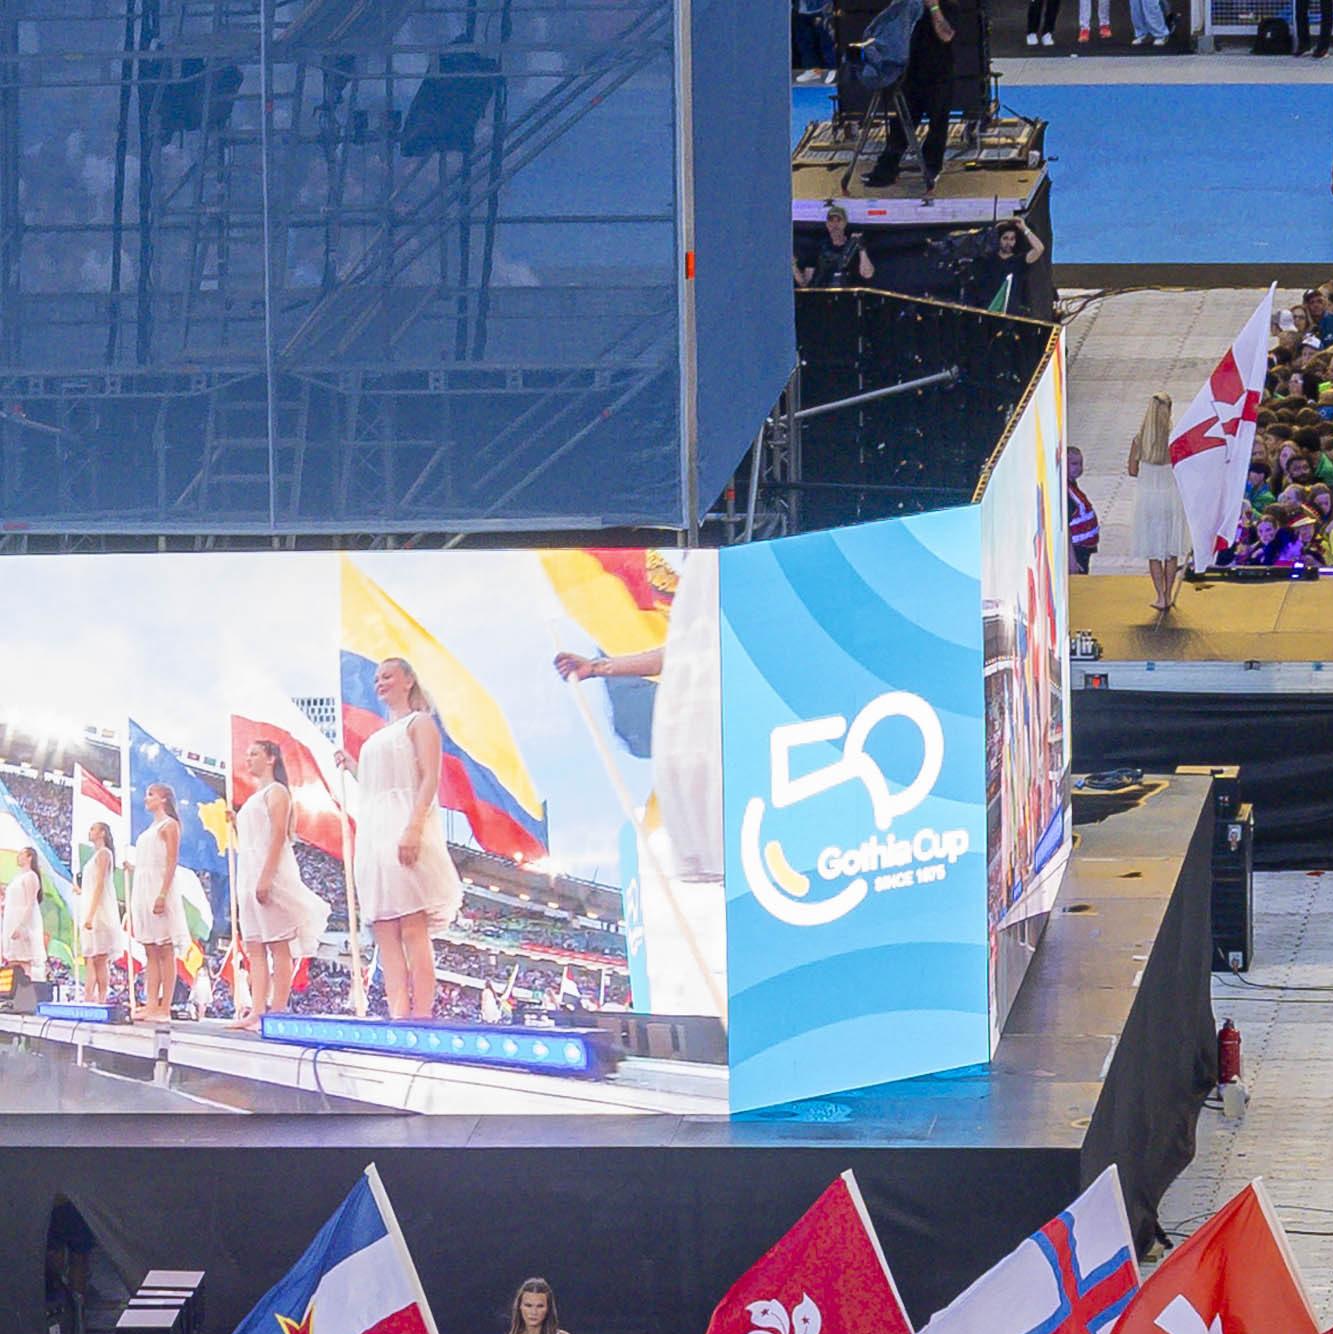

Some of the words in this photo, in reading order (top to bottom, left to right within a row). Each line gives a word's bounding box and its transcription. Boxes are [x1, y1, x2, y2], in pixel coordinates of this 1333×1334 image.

[817, 832, 912, 881] Gothia
[912, 828, 969, 866] Cup
[874, 872, 915, 893] SINCE
